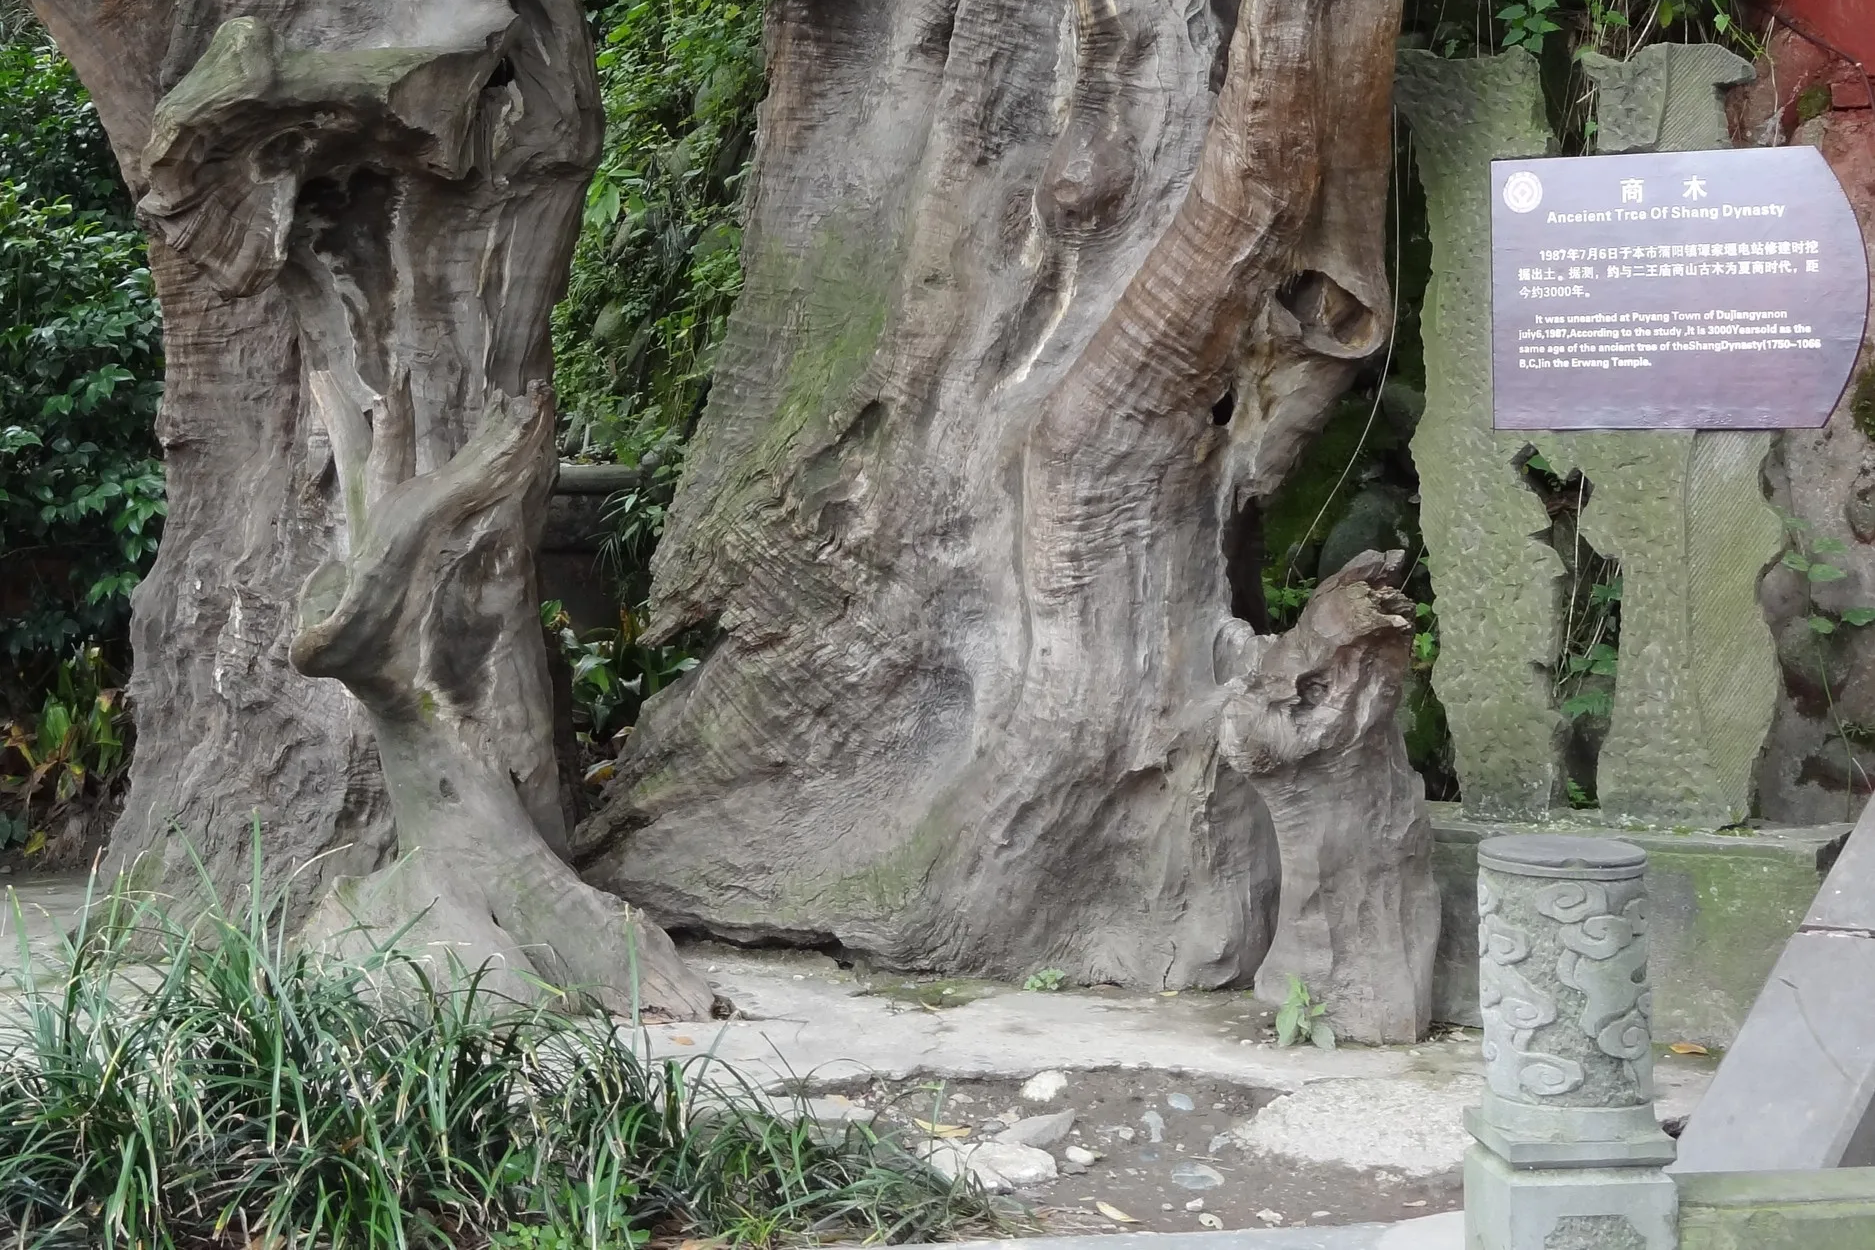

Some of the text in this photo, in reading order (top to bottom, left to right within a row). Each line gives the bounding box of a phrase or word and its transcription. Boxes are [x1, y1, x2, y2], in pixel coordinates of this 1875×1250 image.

[1651, 207, 1668, 219] Of
[1671, 206, 1719, 219] Shang
[1723, 203, 1785, 219] Dynasty
[1519, 284, 1592, 299] 今约3000年。
[1535, 310, 1787, 324] It was unearthed at Puyang Town of Dujiangyanon
[1634, 328, 1651, 336] the
[1654, 327, 1681, 337] study
[1697, 326, 1706, 335] is
[1779, 326, 1791, 334] as
[1794, 324, 1811, 333] the
[1548, 345, 1565, 354] age
[1568, 343, 1578, 352] of
[1580, 344, 1596, 352] the
[1598, 342, 1635, 352] ancient
[1636, 343, 1658, 351] tree
[1660, 342, 1670, 351] of
[1553, 358, 1569, 367] the
[1572, 358, 1609, 368] Erwang
